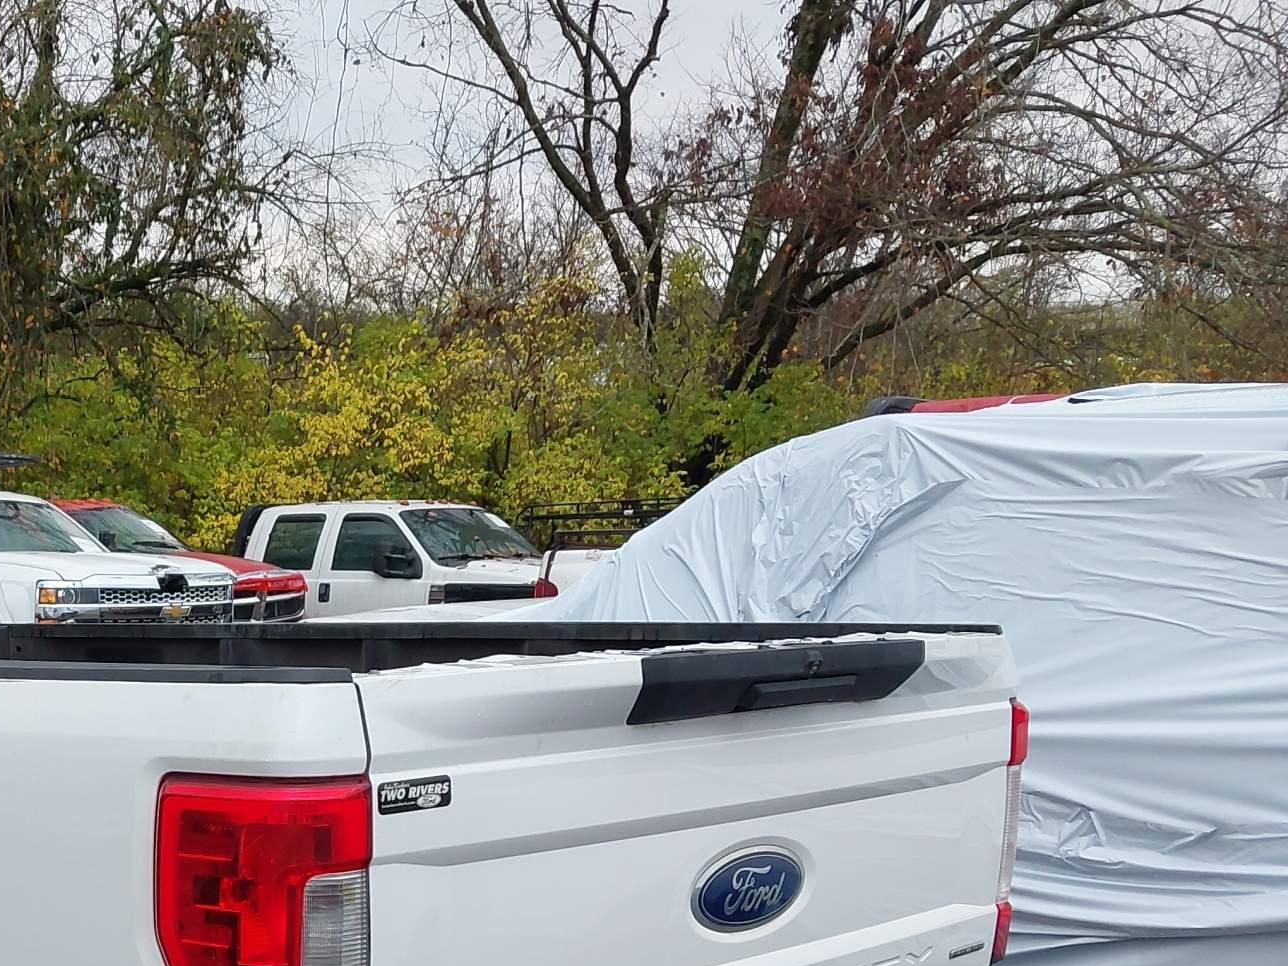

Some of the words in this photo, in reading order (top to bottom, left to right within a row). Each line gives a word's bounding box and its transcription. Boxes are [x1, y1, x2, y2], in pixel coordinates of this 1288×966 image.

[380, 787, 407, 803] TWO
[407, 781, 450, 799] RIVERS
[723, 864, 786, 916] Ford
